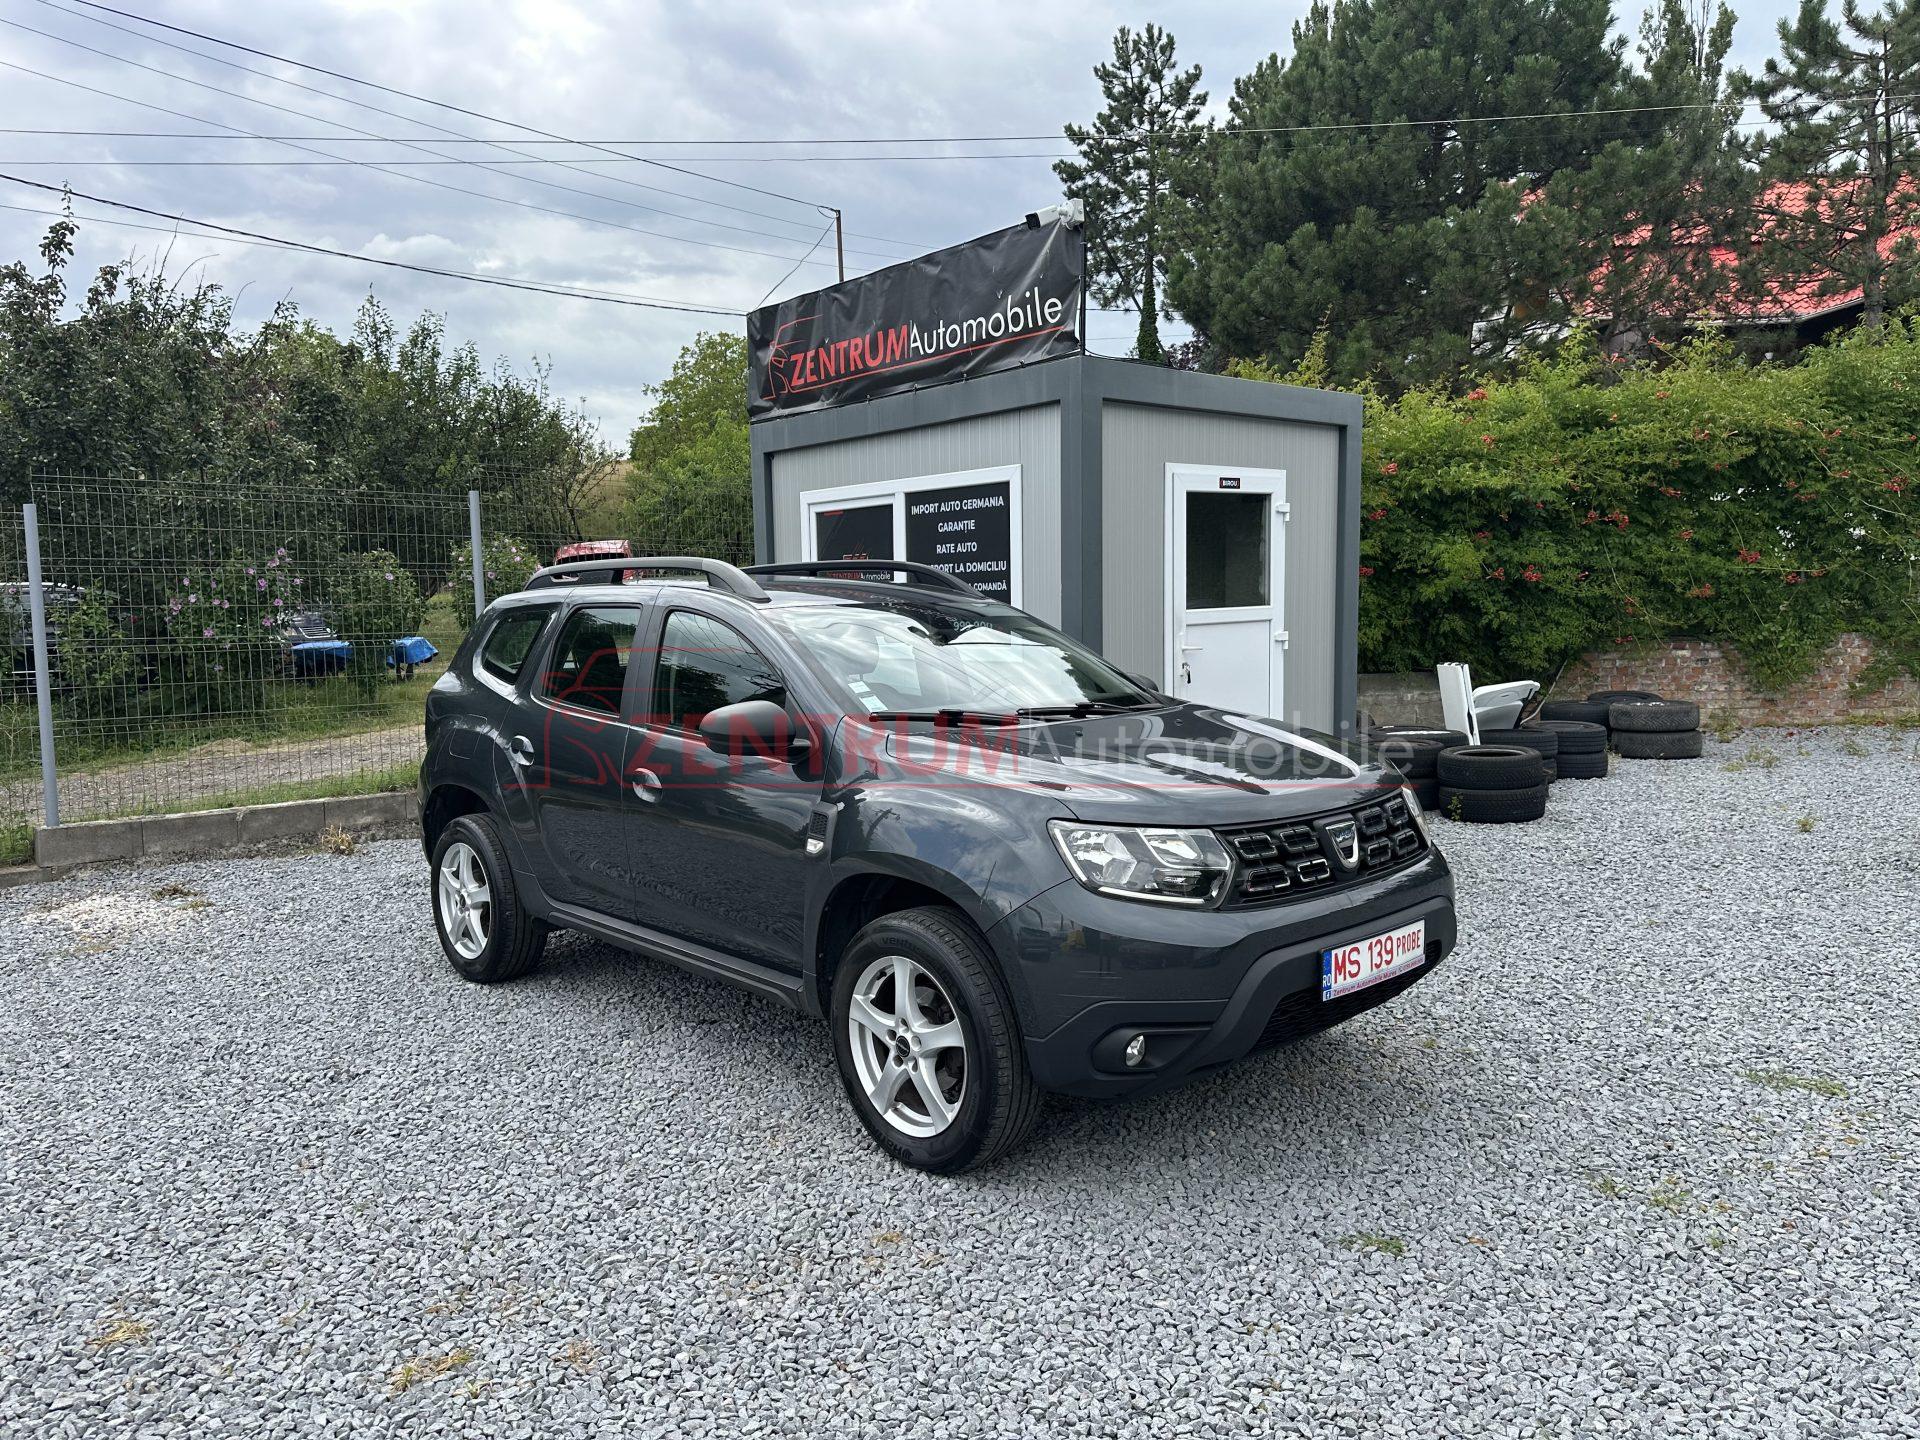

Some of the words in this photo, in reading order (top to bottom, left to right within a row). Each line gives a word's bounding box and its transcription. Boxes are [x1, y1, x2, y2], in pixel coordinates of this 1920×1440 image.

[790, 324, 909, 388] ZENTRUM
[910, 286, 1062, 356] Automobile
[911, 502, 939, 516] IMPORT
[940, 500, 961, 513] AUTO
[962, 495, 1005, 510] GERMANIA
[936, 544, 955, 555] RATE
[956, 541, 978, 553] AUTO
[955, 562, 965, 573] LA
[966, 560, 1007, 573] DOMICILIU
[1333, 946, 1361, 985] MS
[1367, 935, 1395, 972] 139
[1396, 928, 1422, 957] PROBE
[1322, 974, 1332, 989] RO
